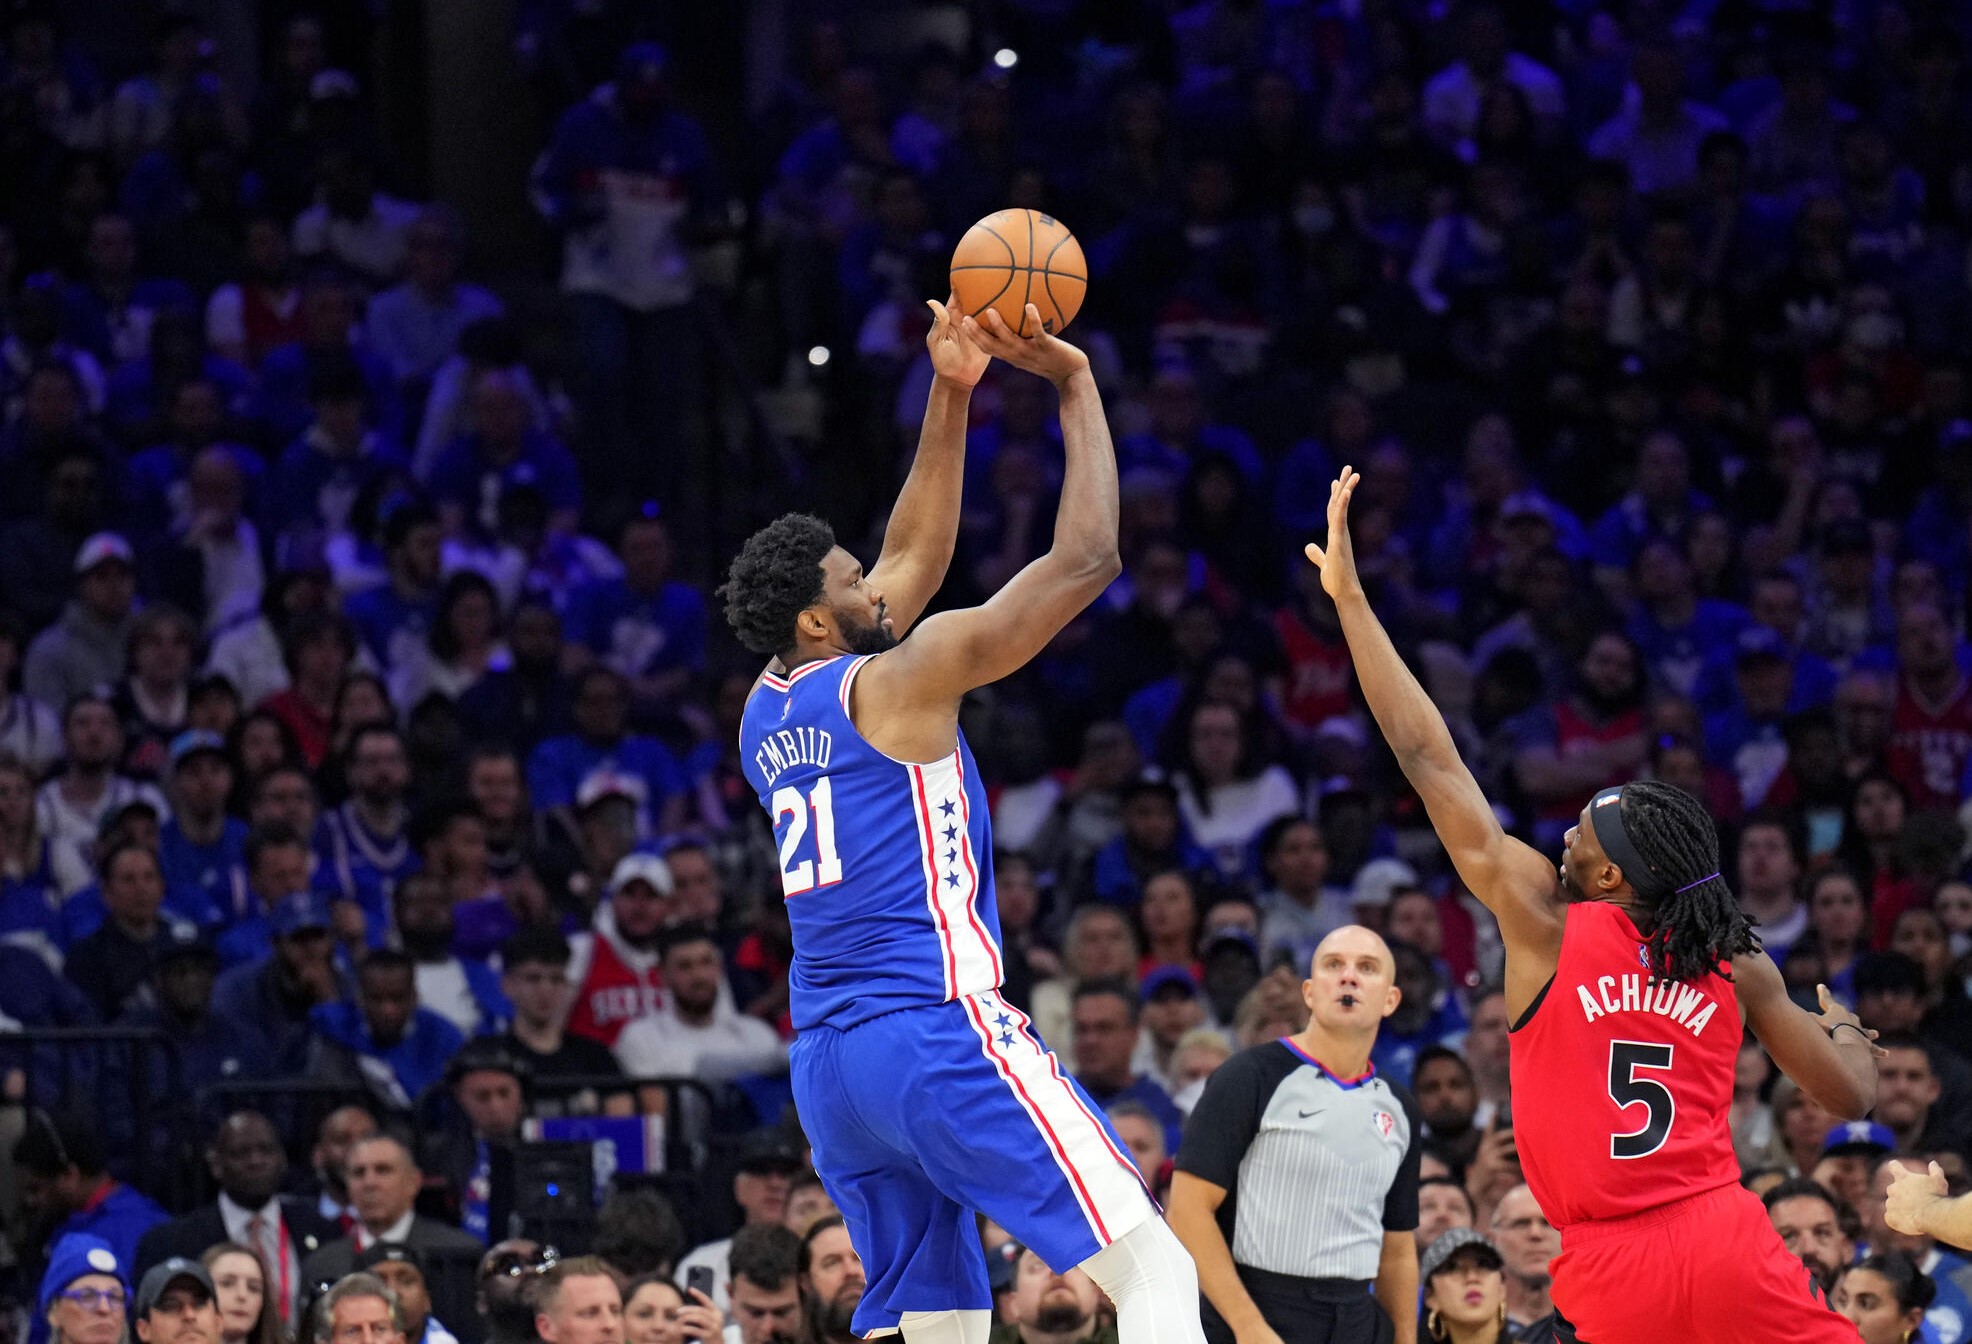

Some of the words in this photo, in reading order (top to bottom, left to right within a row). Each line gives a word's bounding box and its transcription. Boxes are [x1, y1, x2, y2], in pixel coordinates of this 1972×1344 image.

[756, 727, 832, 787] EMBIID
[772, 776, 842, 899] 21
[1608, 1039, 1675, 1159] 5
